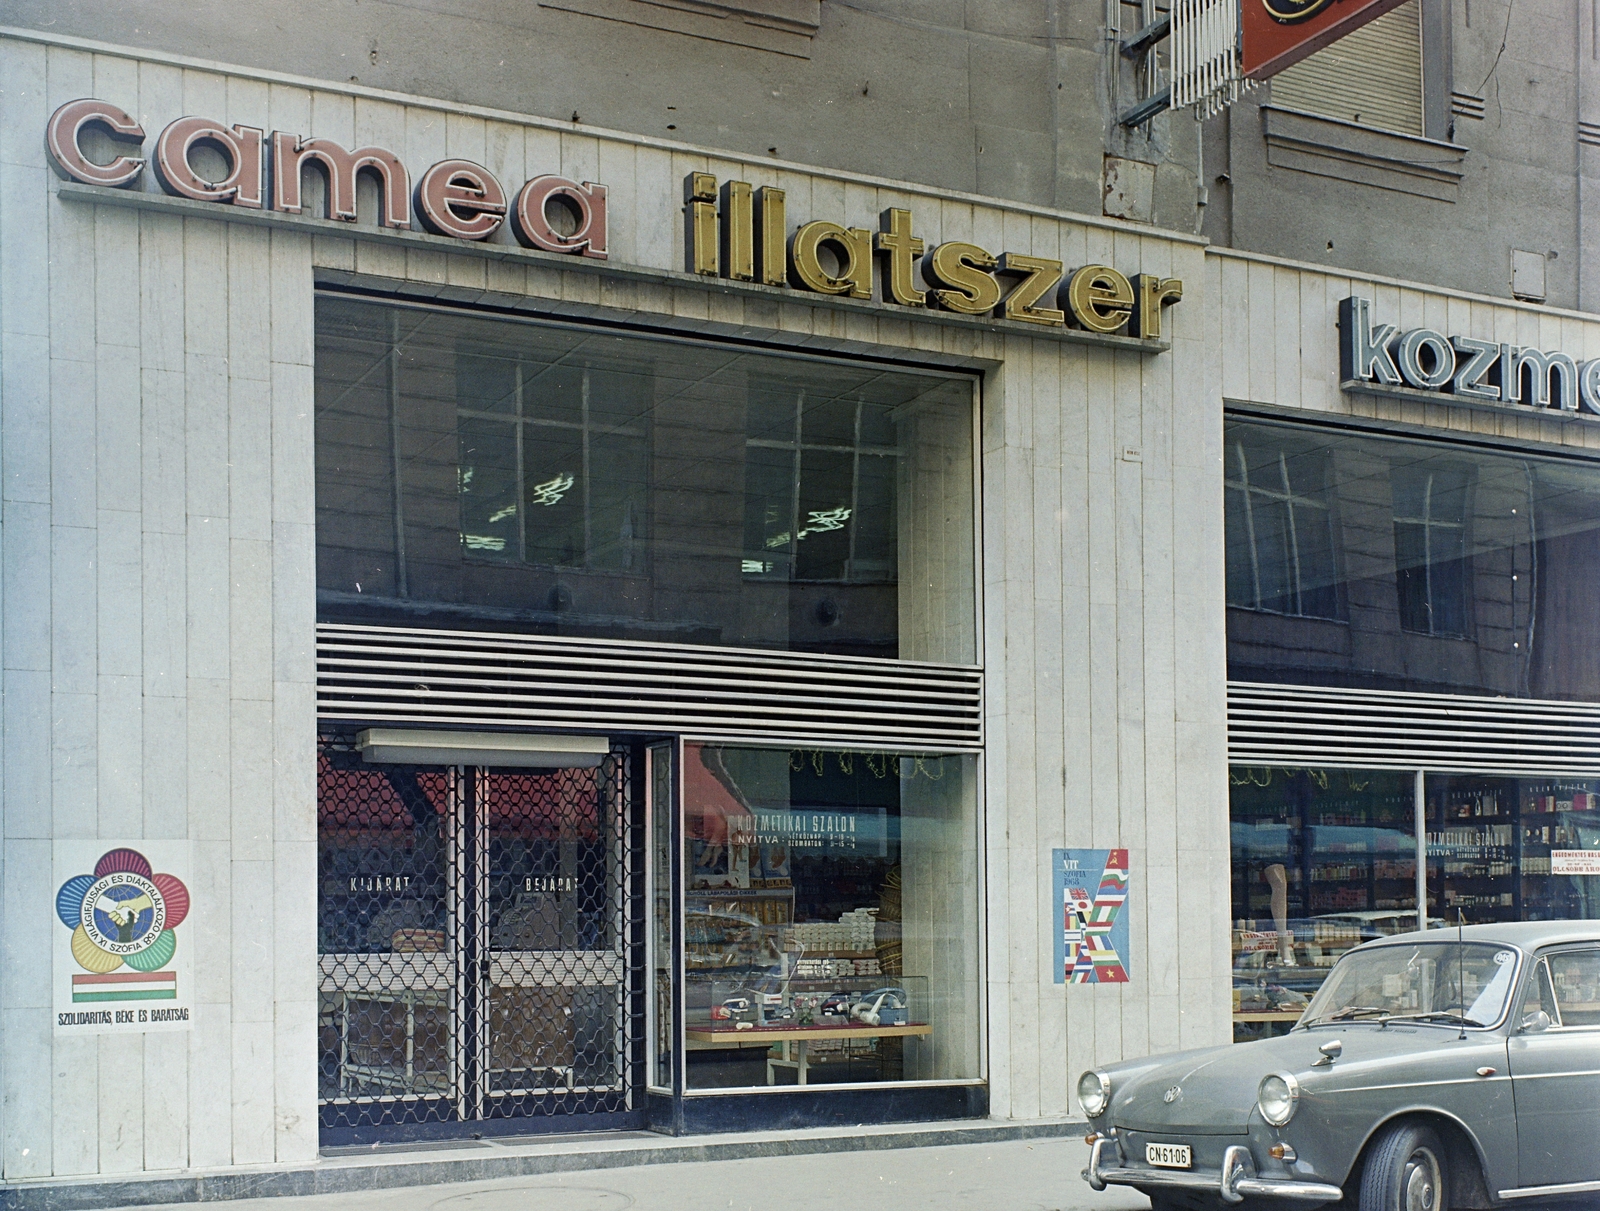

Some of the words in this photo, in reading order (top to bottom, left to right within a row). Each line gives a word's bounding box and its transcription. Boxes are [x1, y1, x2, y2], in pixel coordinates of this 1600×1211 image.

[46, 98, 609, 260] camea
[682, 171, 1183, 340] illatszer
[737, 815, 806, 832] KOZMETIKAI
[1063, 860, 1079, 870] VIT
[111, 875, 124, 884] ÉS
[350, 874, 410, 892] KIJÁRAT
[1063, 878, 1080, 886] 1968
[109, 941, 142, 953] SZÓFIA
[58, 1009, 113, 1026] SZOLIDARITÁS,
[115, 1009, 134, 1023] BÉKE
[138, 1008, 148, 1022] ÉS
[150, 1006, 189, 1022] BARÁTSÁG
